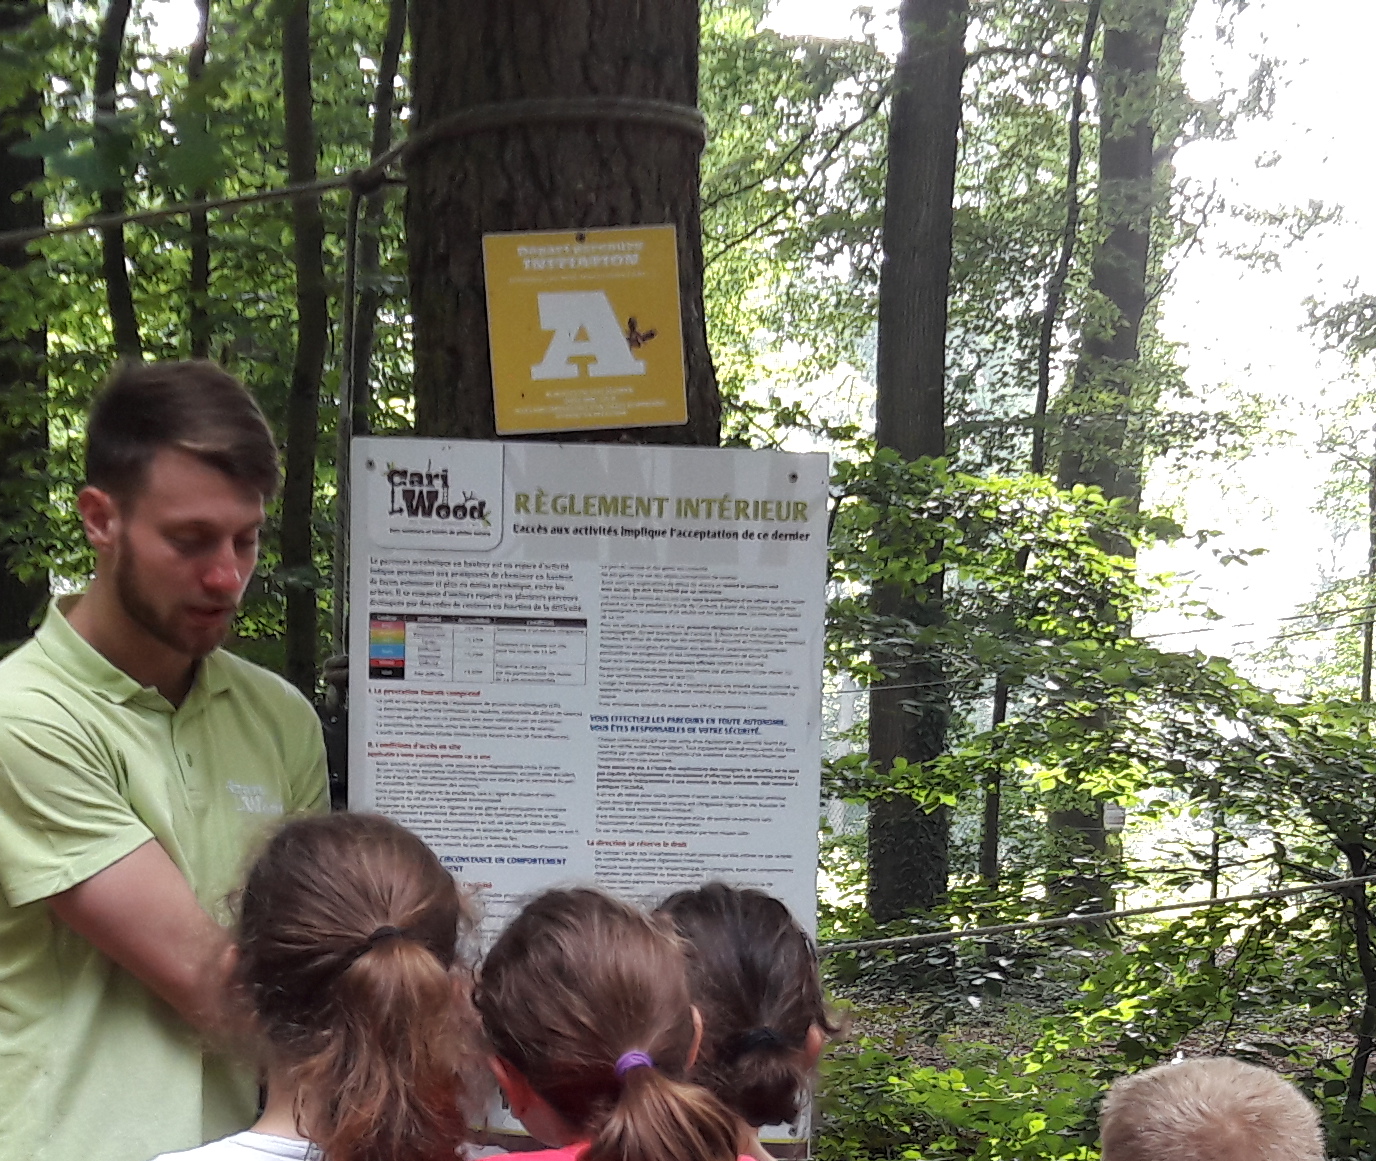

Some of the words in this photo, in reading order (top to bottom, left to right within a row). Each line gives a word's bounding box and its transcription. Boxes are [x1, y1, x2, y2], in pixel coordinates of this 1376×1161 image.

[530, 290, 646, 381] A
[402, 489, 486, 520] Wood
[513, 488, 670, 519] RÈGLEMENT
[675, 494, 809, 522] INTÉRIEUR
[550, 525, 570, 535] aux
[572, 525, 619, 536] activités
[620, 525, 667, 540] implique
[670, 526, 739, 541] l'acceptation
[742, 529, 755, 541] de
[757, 531, 769, 541] ce
[771, 529, 811, 542] dernier
